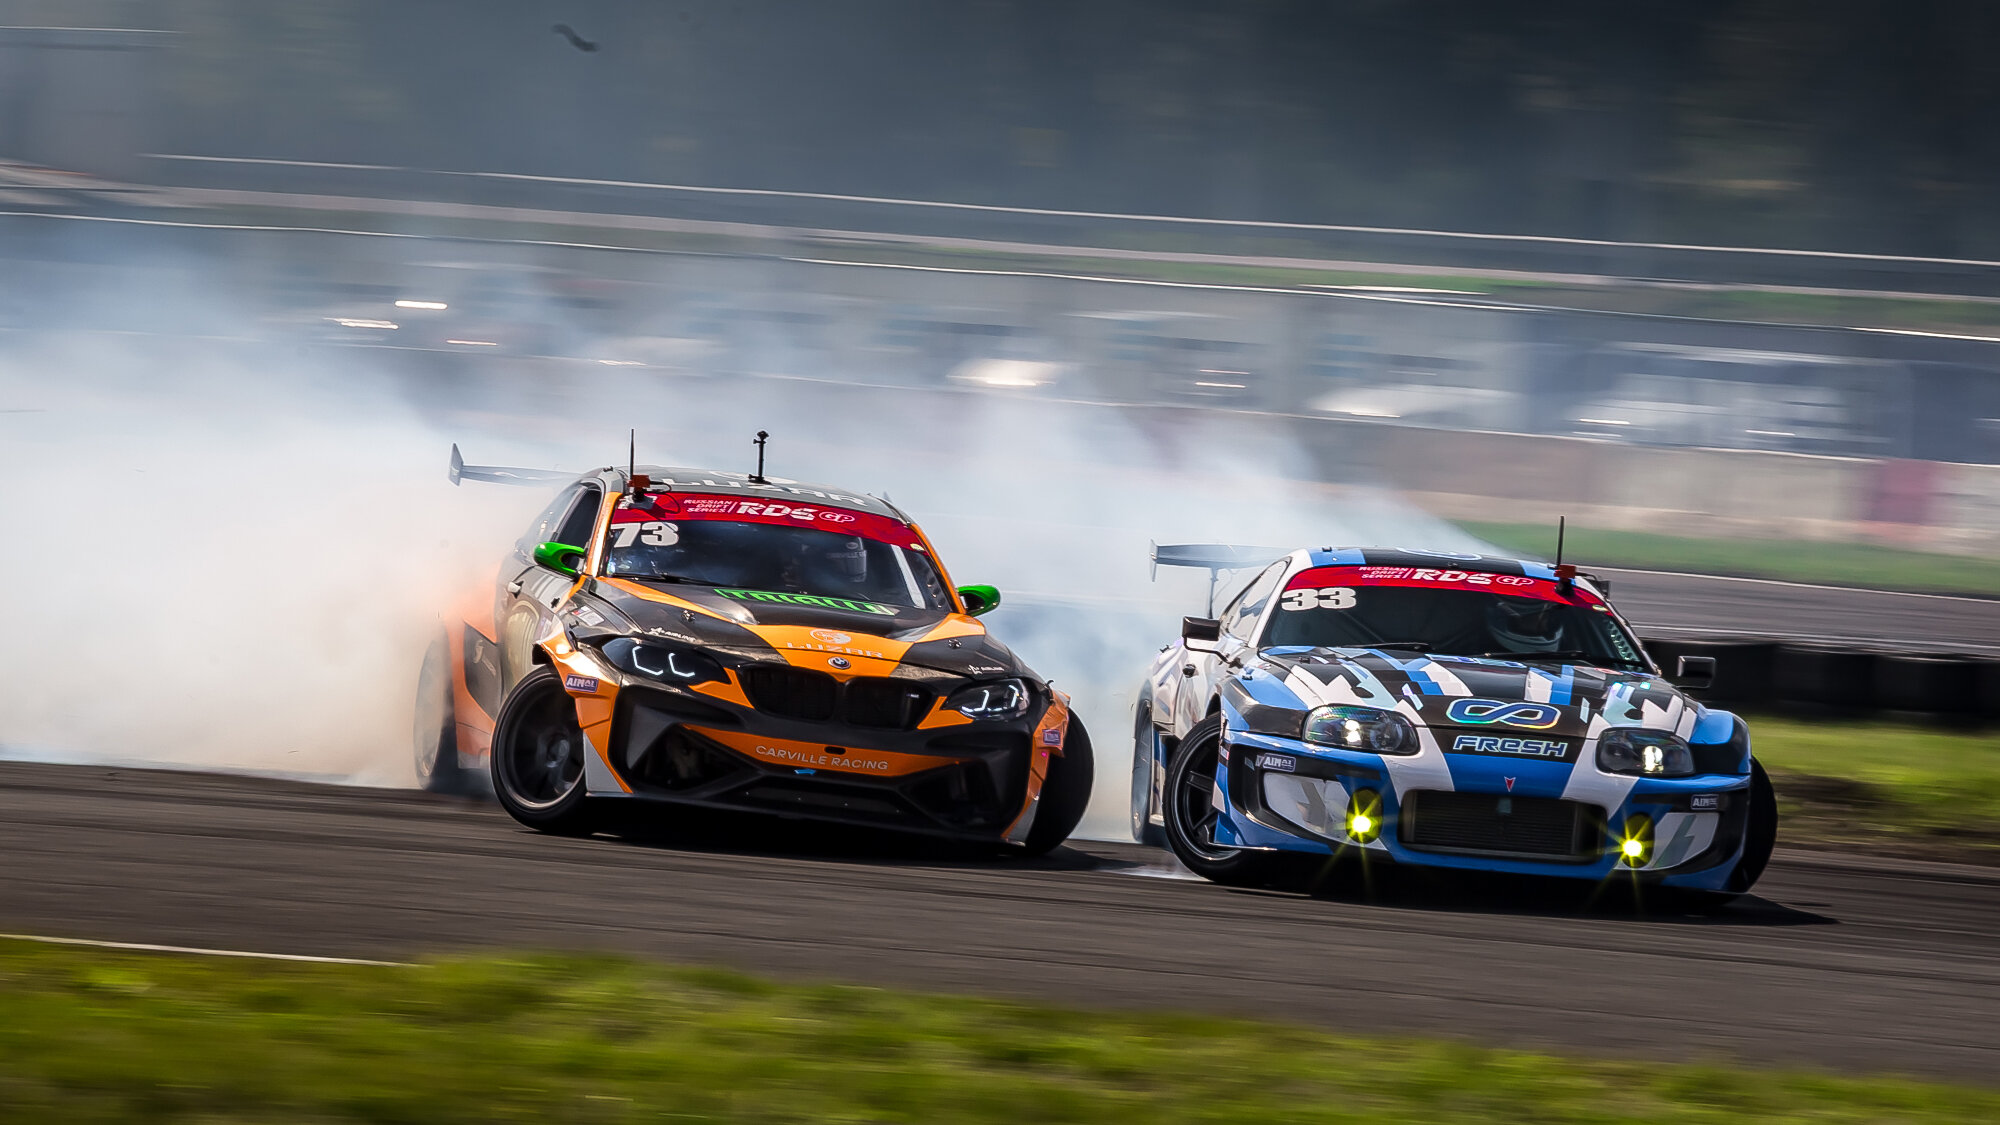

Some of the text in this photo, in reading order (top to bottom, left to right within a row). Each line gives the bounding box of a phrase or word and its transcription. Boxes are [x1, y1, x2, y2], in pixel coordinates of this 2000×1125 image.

[661, 478, 868, 507] LUZAR
[736, 501, 856, 523] RDS GP
[610, 521, 680, 548] 73
[1411, 568, 1535, 586] RDS GP
[1281, 587, 1357, 612] 33
[786, 641, 883, 658] LUZAR
[755, 745, 889, 771] CARVILLE RACING
